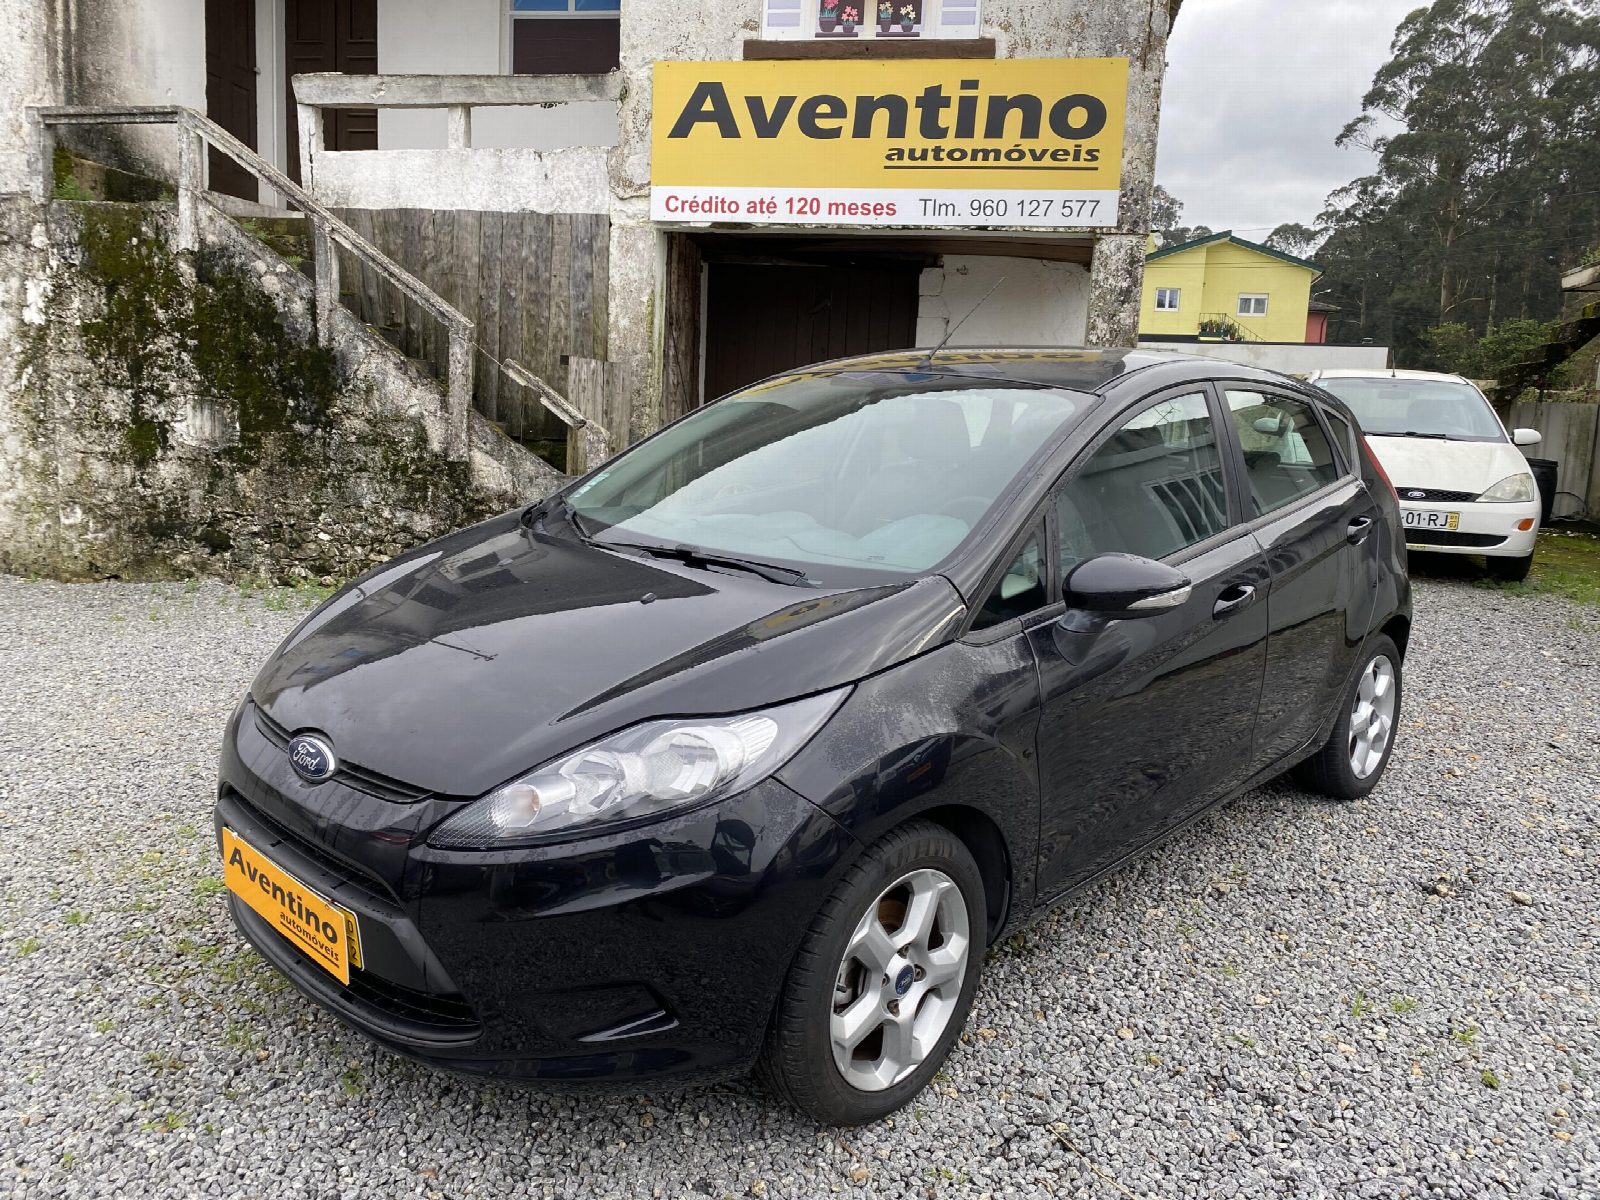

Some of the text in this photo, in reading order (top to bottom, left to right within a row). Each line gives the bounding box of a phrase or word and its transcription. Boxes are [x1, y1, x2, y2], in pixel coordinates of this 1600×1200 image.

[667, 79, 1108, 140] Aventino
[884, 144, 1100, 162] automóveis
[665, 195, 897, 217] Crédito até 120 meses
[919, 199, 1101, 218] Tlm. 960 127 577
[293, 742, 320, 770] Ford
[229, 847, 338, 944] Aventino
[280, 912, 339, 961] automóveis
